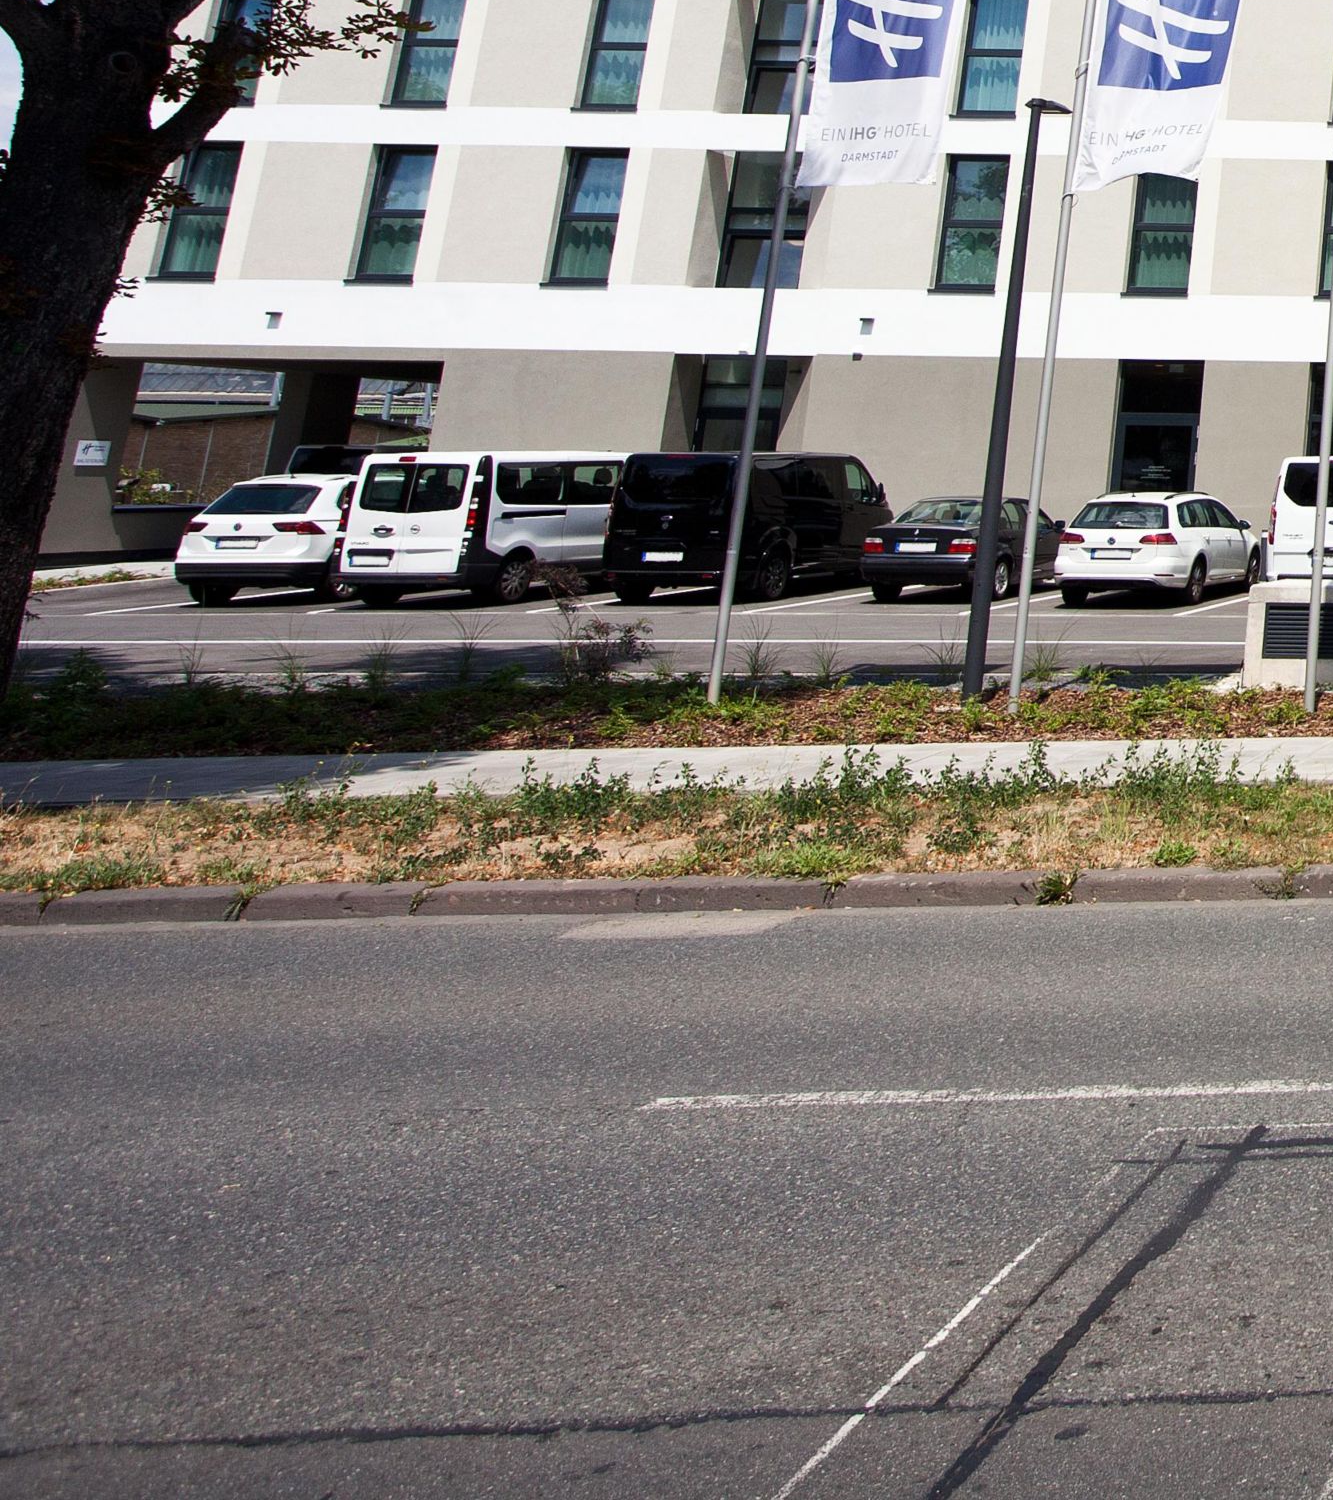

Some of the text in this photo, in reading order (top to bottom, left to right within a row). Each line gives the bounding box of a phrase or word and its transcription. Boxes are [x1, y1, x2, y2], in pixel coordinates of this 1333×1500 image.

[821, 122, 932, 142] EIN IHG HOTEL
[1088, 130, 1119, 147] EIN
[1151, 123, 1204, 137] HOTEL
[841, 149, 899, 163] DARMSTADT
